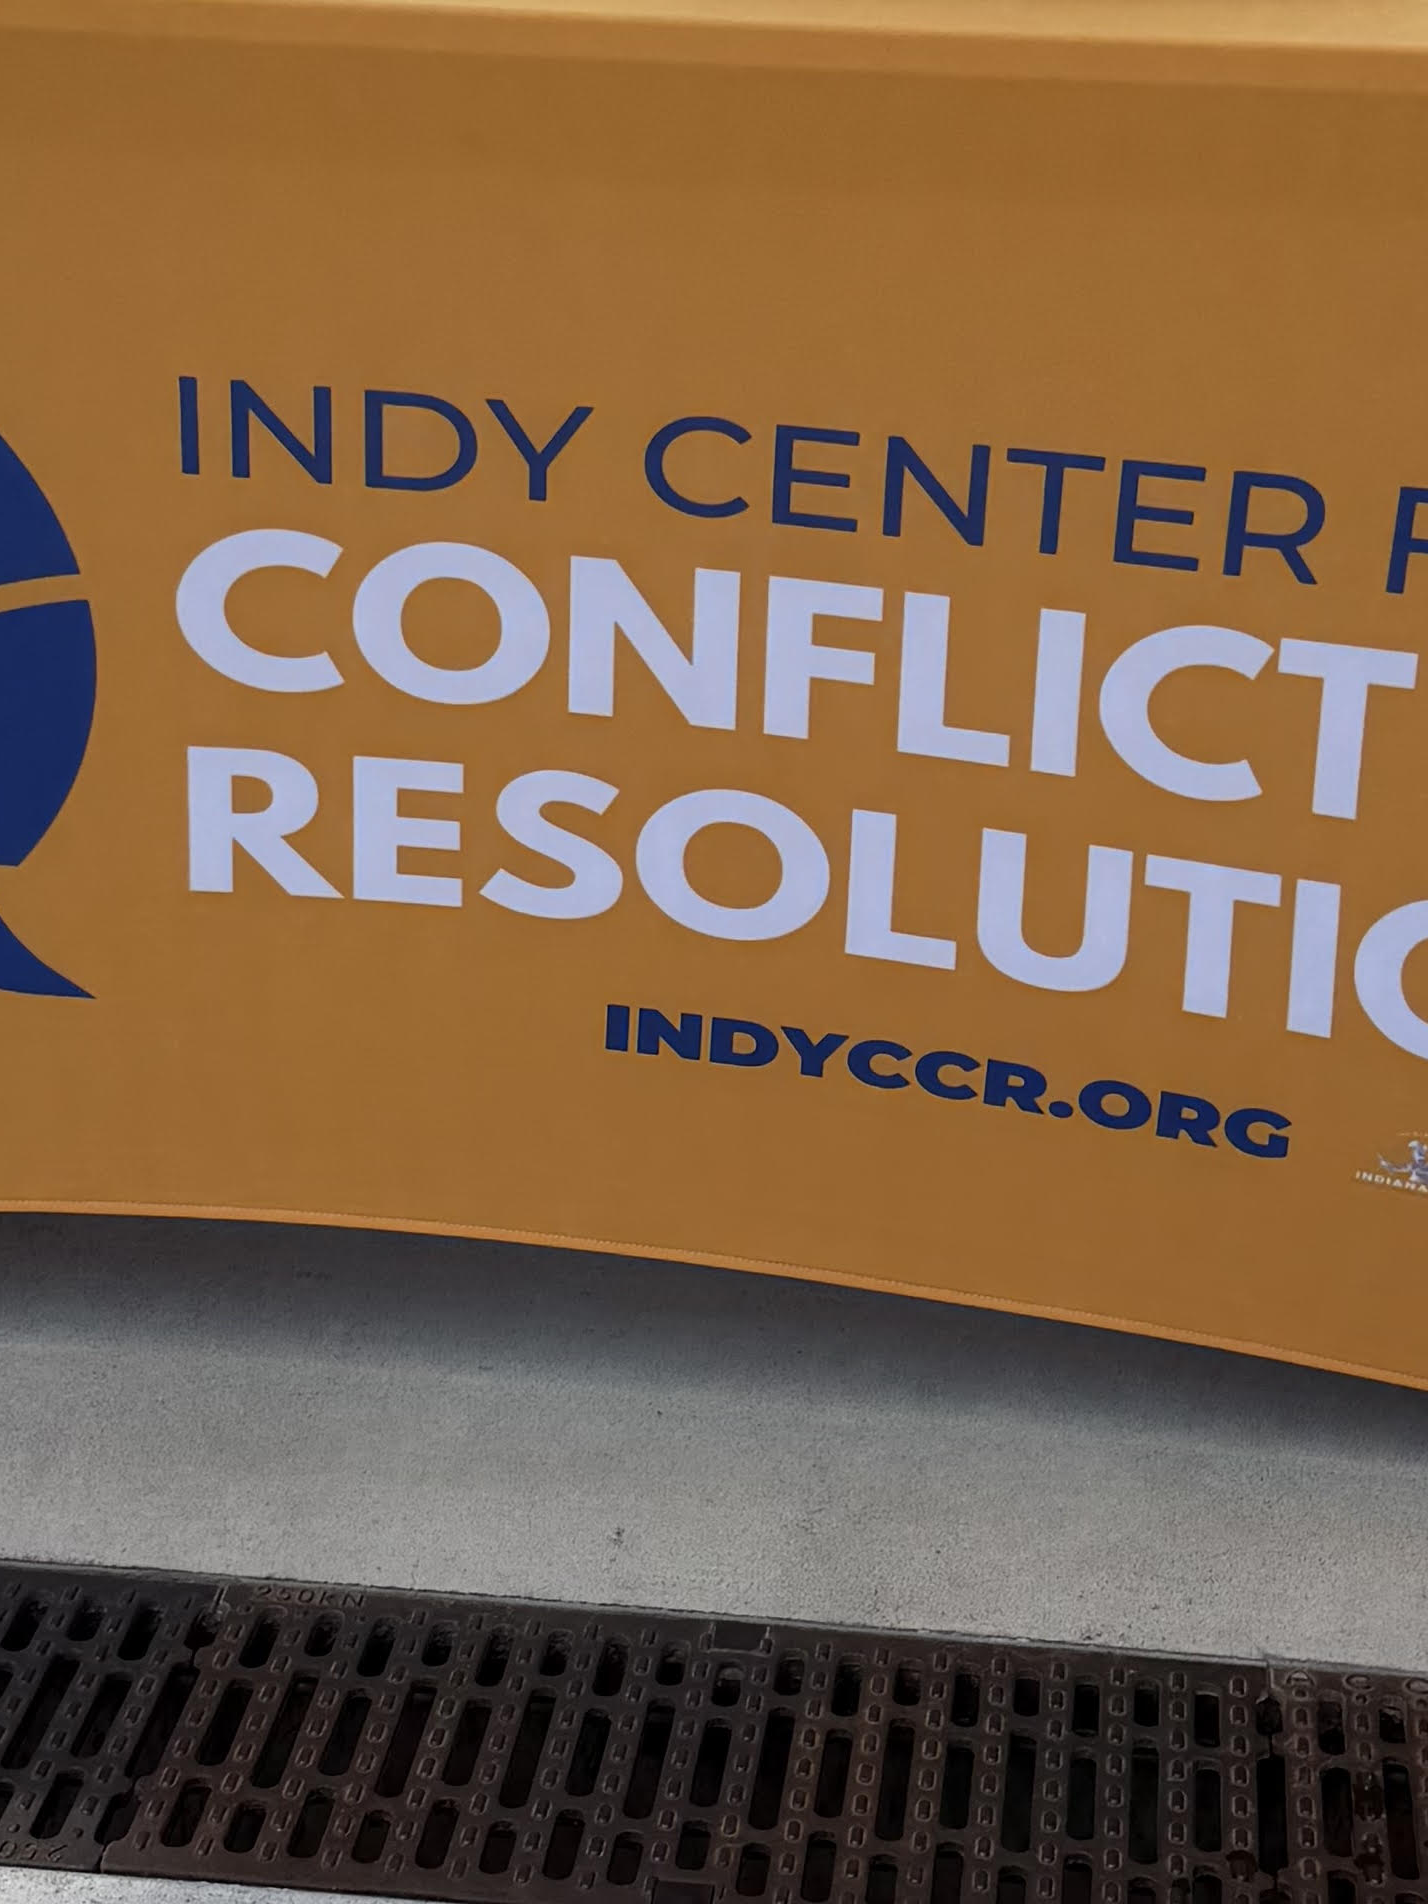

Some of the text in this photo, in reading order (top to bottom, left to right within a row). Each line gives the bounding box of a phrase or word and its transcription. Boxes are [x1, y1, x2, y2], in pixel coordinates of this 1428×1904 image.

[178, 376, 591, 502] INDY
[644, 416, 1326, 585] CENTER
[174, 528, 1419, 821] CONFLICT
[604, 1004, 1290, 1159] INDYCCR.ORG
